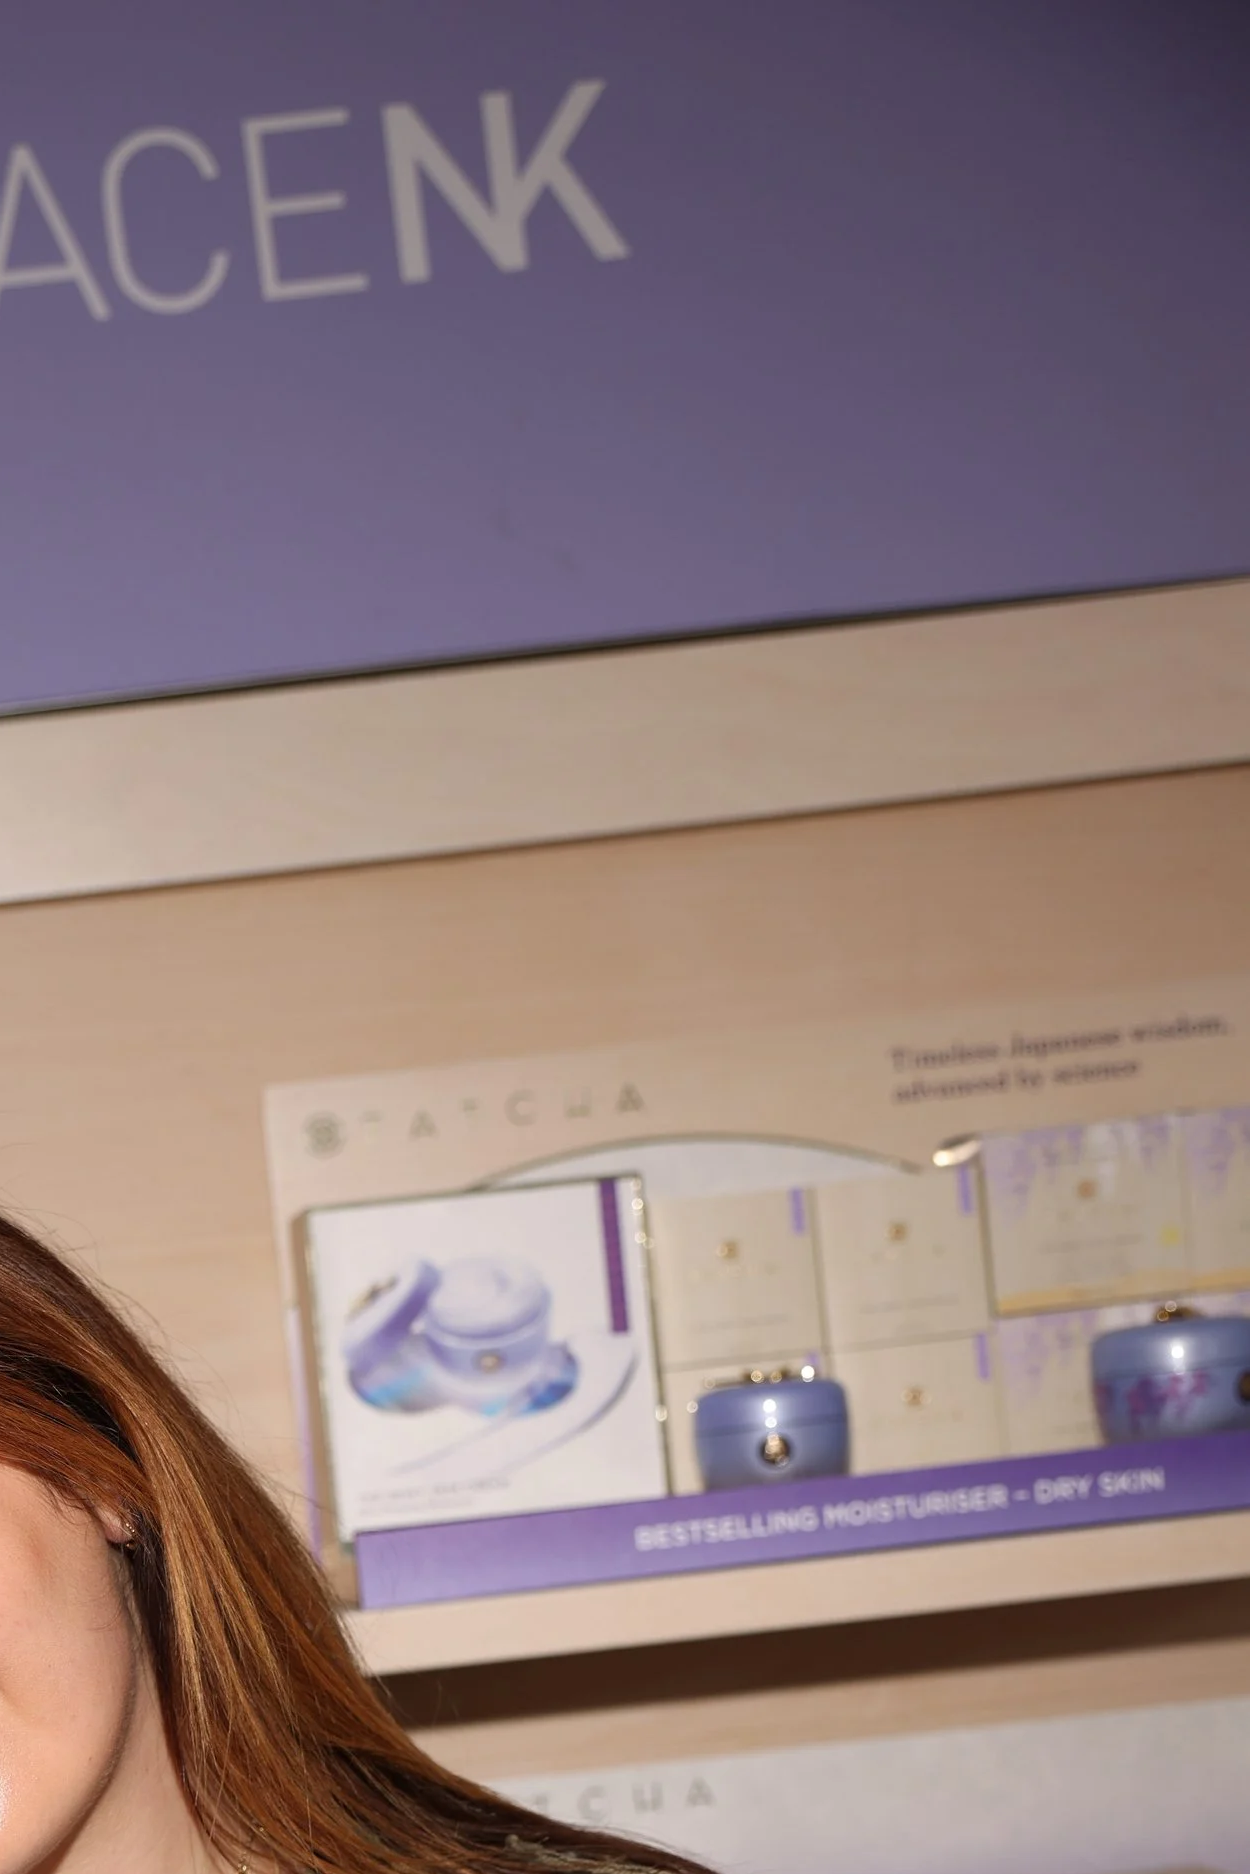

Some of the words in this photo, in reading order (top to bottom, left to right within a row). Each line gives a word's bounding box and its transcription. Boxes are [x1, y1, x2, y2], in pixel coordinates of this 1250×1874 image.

[1009, 1029, 1123, 1060] Japanese
[892, 1069, 1011, 1104] advanced
[1015, 1066, 1045, 1096] by
[634, 1505, 820, 1551] BESTSELLING
[823, 1482, 1010, 1529] MOISTURISER
[1034, 1473, 1092, 1505] DRY
[1097, 1467, 1166, 1498] SKIN
